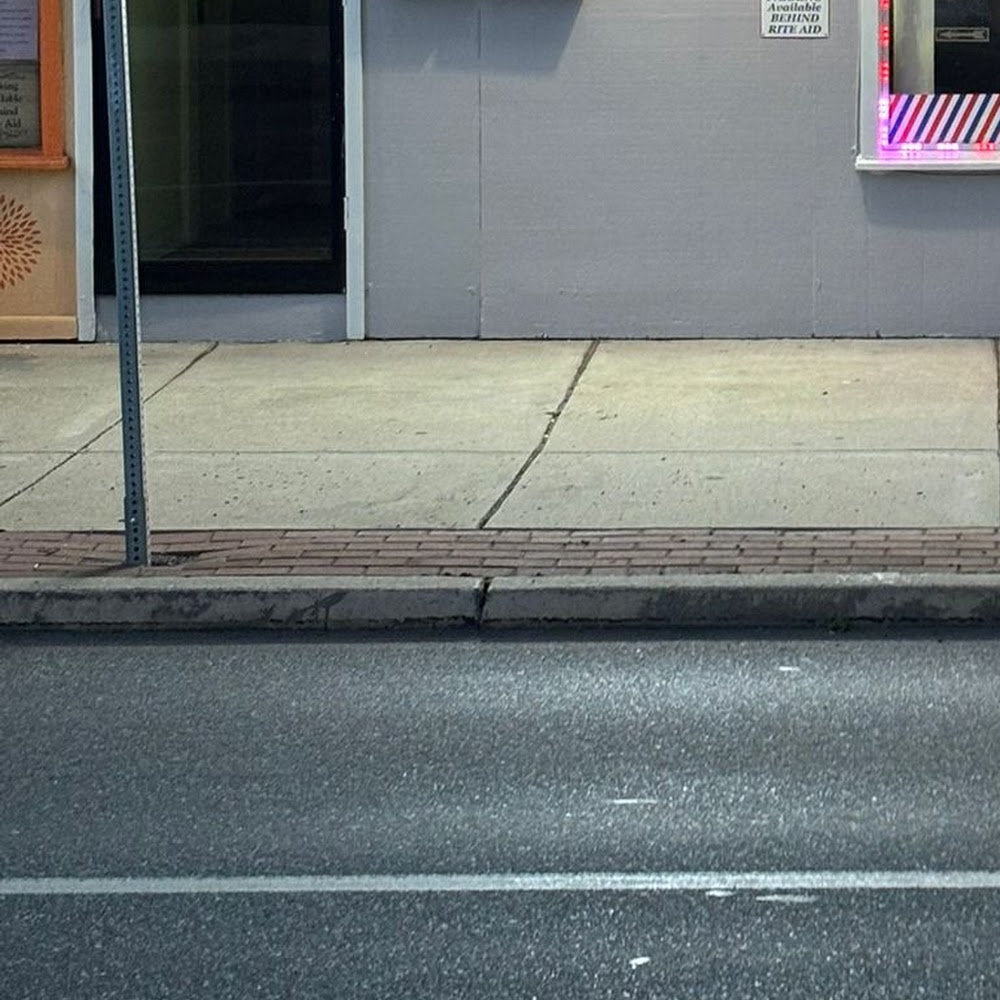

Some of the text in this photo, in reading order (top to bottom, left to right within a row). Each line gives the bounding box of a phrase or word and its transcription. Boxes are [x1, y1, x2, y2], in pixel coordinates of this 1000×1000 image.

[767, 2, 822, 12] Available
[771, 13, 820, 22] BEHIND
[768, 25, 822, 34] RITE AID
